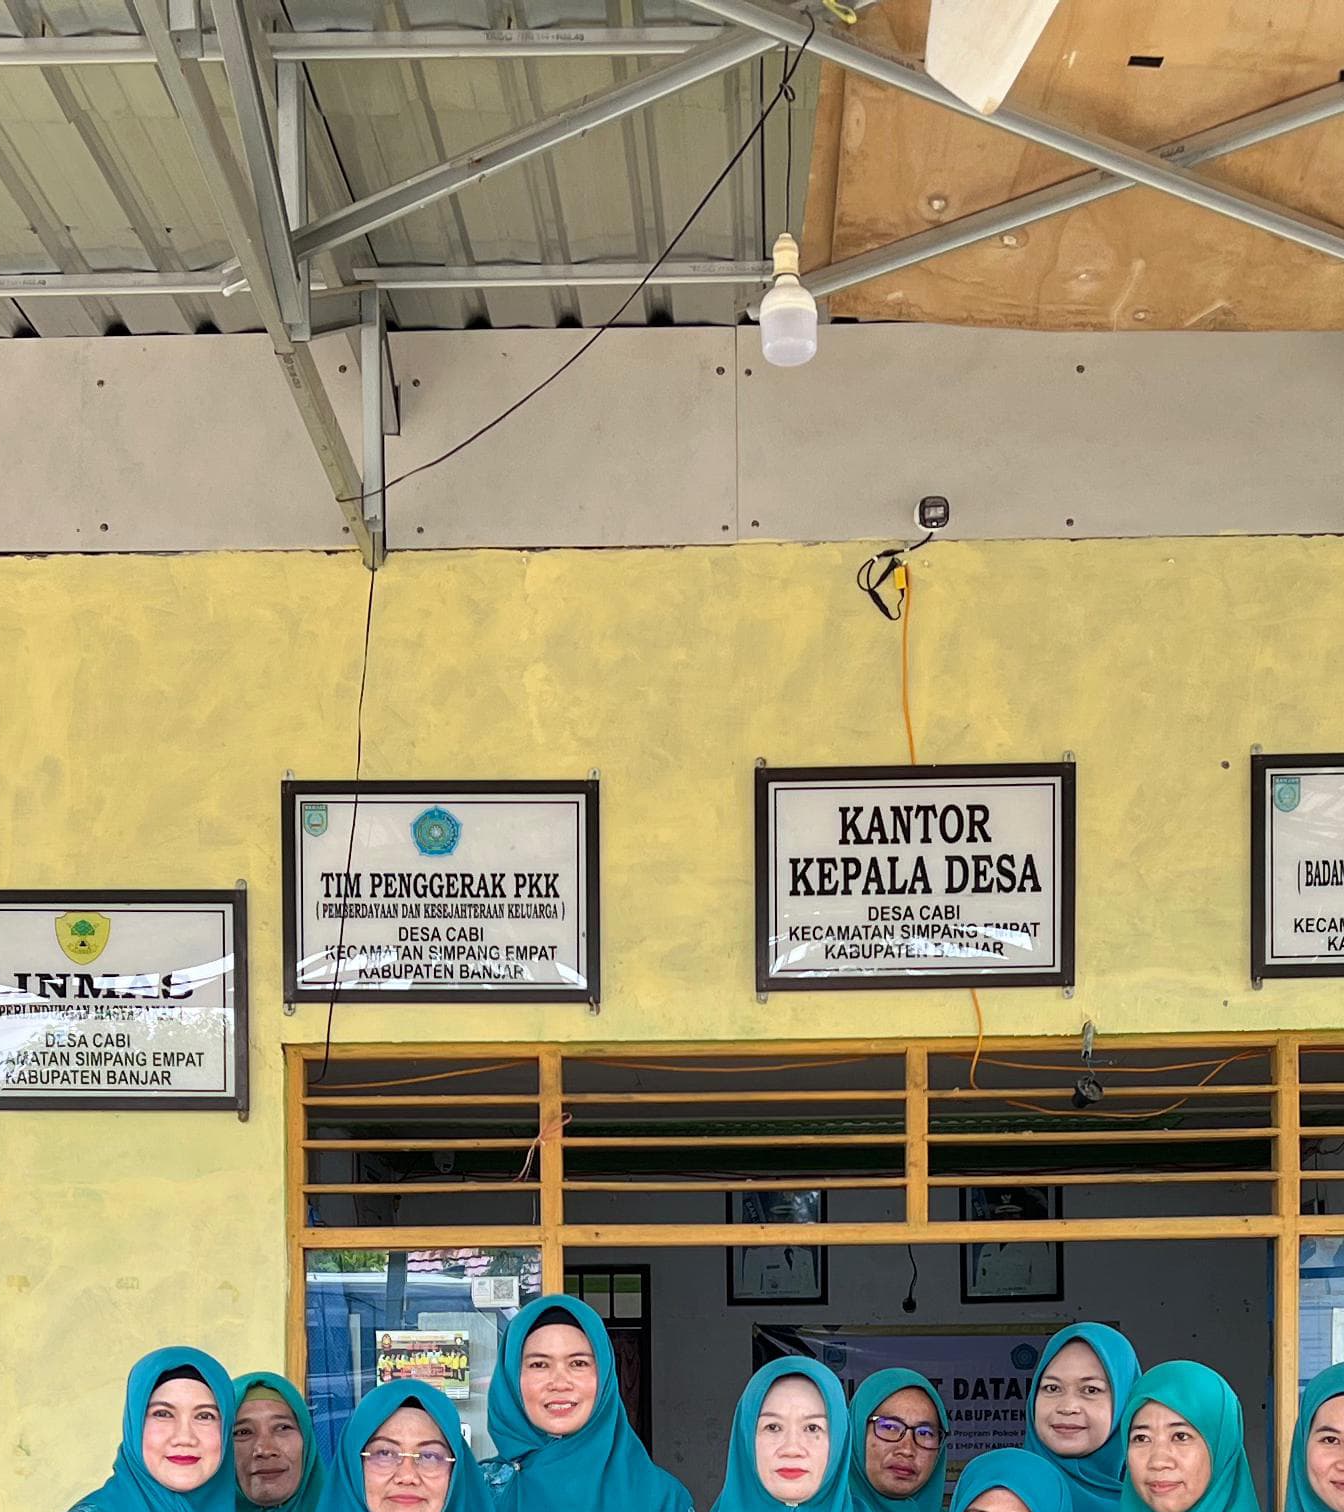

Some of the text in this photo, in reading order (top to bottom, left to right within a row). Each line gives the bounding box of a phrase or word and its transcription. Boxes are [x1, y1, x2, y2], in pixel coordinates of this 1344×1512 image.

[838, 804, 992, 845] KANTOR
[789, 854, 1042, 896] KEPALA DESA
[320, 872, 560, 898] TIM PENGGERAK PKK
[322, 903, 399, 919] PEMBERDAYAAN
[402, 903, 421, 919] DAN
[424, 903, 505, 919] KESEJAHTERAAN
[508, 903, 558, 919] KELUARGA
[868, 905, 961, 921] DESA CABI
[399, 927, 484, 941] DESA CABI
[788, 925, 895, 941] KECAMATAN
[901, 923, 978, 939] SIMPANG
[325, 945, 557, 960] KECAMATAN SIMPANG EMPAT
[825, 943, 927, 959] KABUPATEN
[359, 964, 524, 979] KABUPATEN BANJAR
[45, 1033, 131, 1048] DESA CABI
[75, 1051, 147, 1067] SIMPANG
[154, 1052, 205, 1067] EMPAT
[6, 1070, 172, 1086] KABUPATEN BANJAR
[954, 1377, 1032, 1401] DATA
